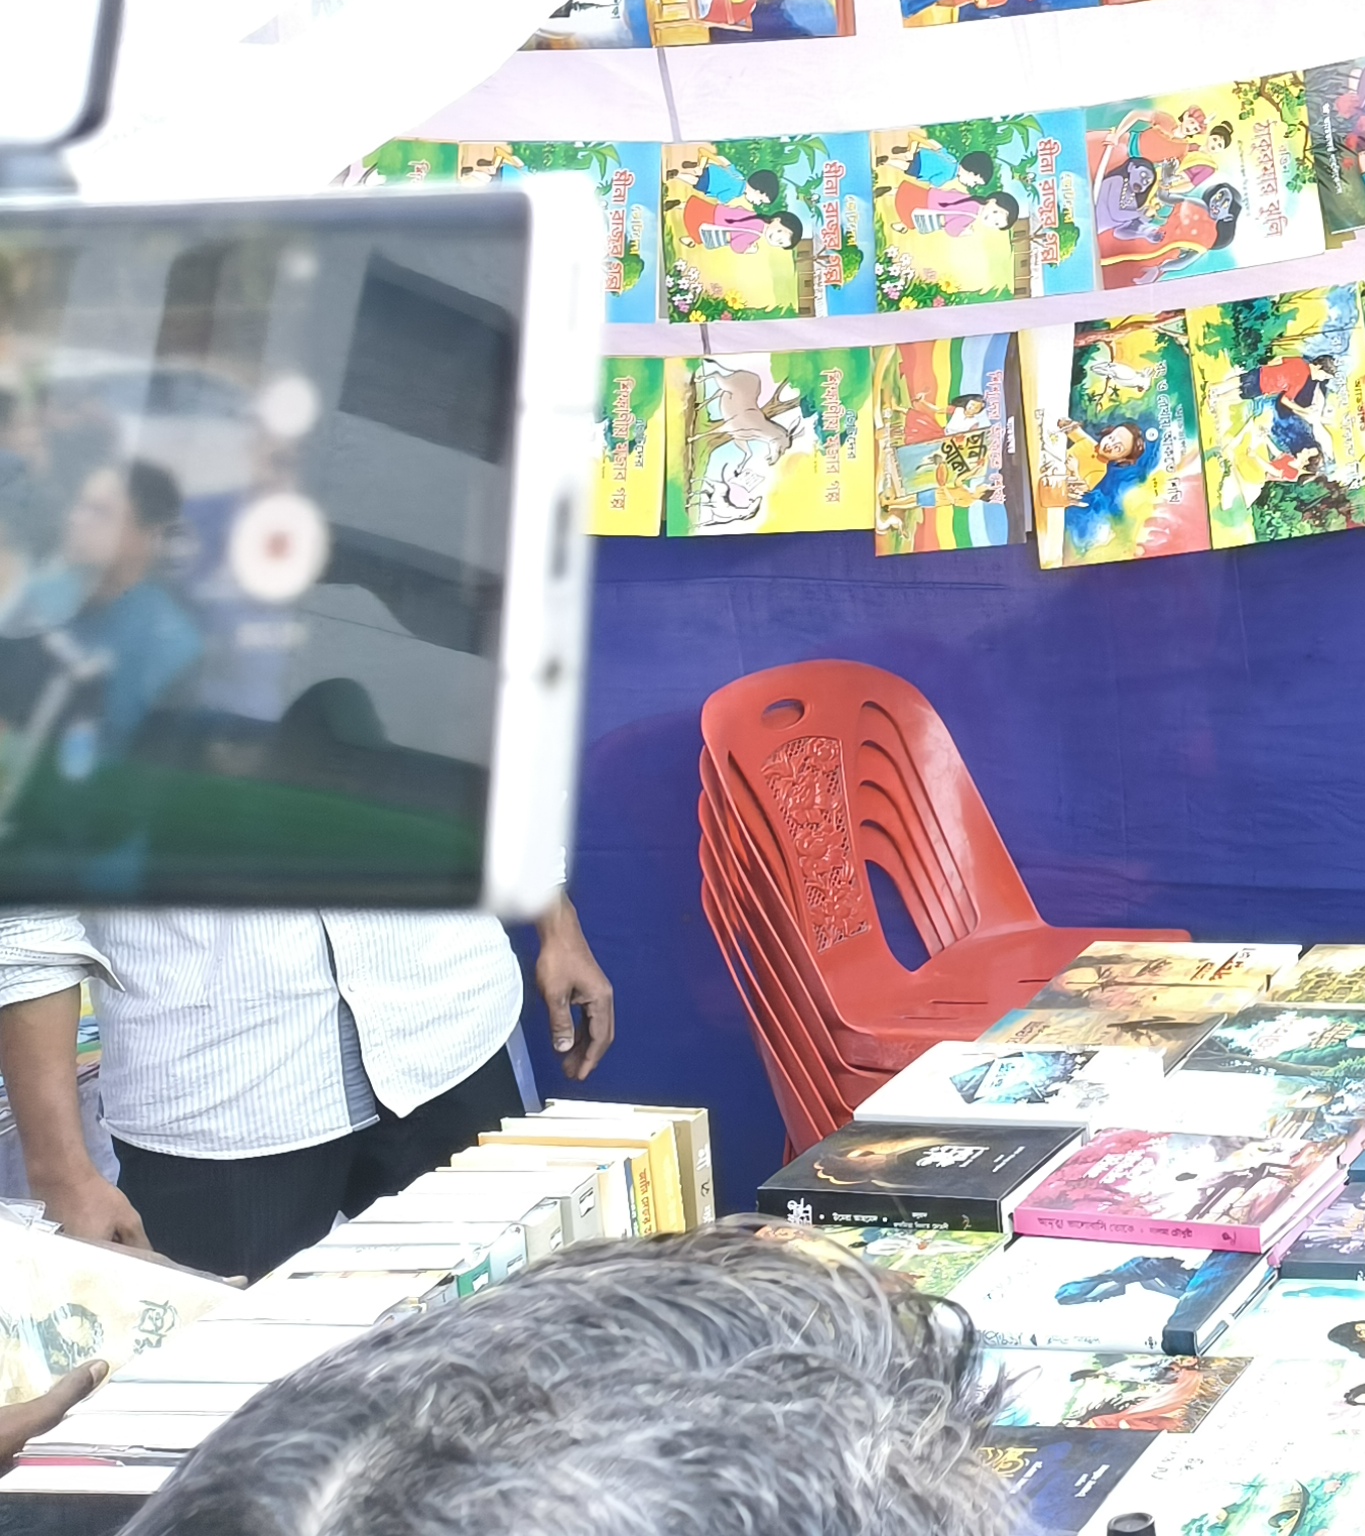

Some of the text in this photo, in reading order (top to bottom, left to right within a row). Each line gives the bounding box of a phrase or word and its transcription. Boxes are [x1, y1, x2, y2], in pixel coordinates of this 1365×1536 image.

[1037, 138, 1062, 264] মীনা রাজুর গল্প
[604, 170, 634, 292] মীনা রাজুর গল্প
[821, 160, 846, 286] মীনা রাজুর গল্প
[634, 419, 645, 468] ছোটদের
[846, 410, 858, 459] ছোটদের
[966, 432, 988, 460] ছবি
[612, 443, 630, 481] মজার
[824, 437, 841, 475] মজার
[941, 439, 970, 478] আঁকা
[611, 487, 626, 510] গল্প
[824, 480, 841, 503] গল্প
